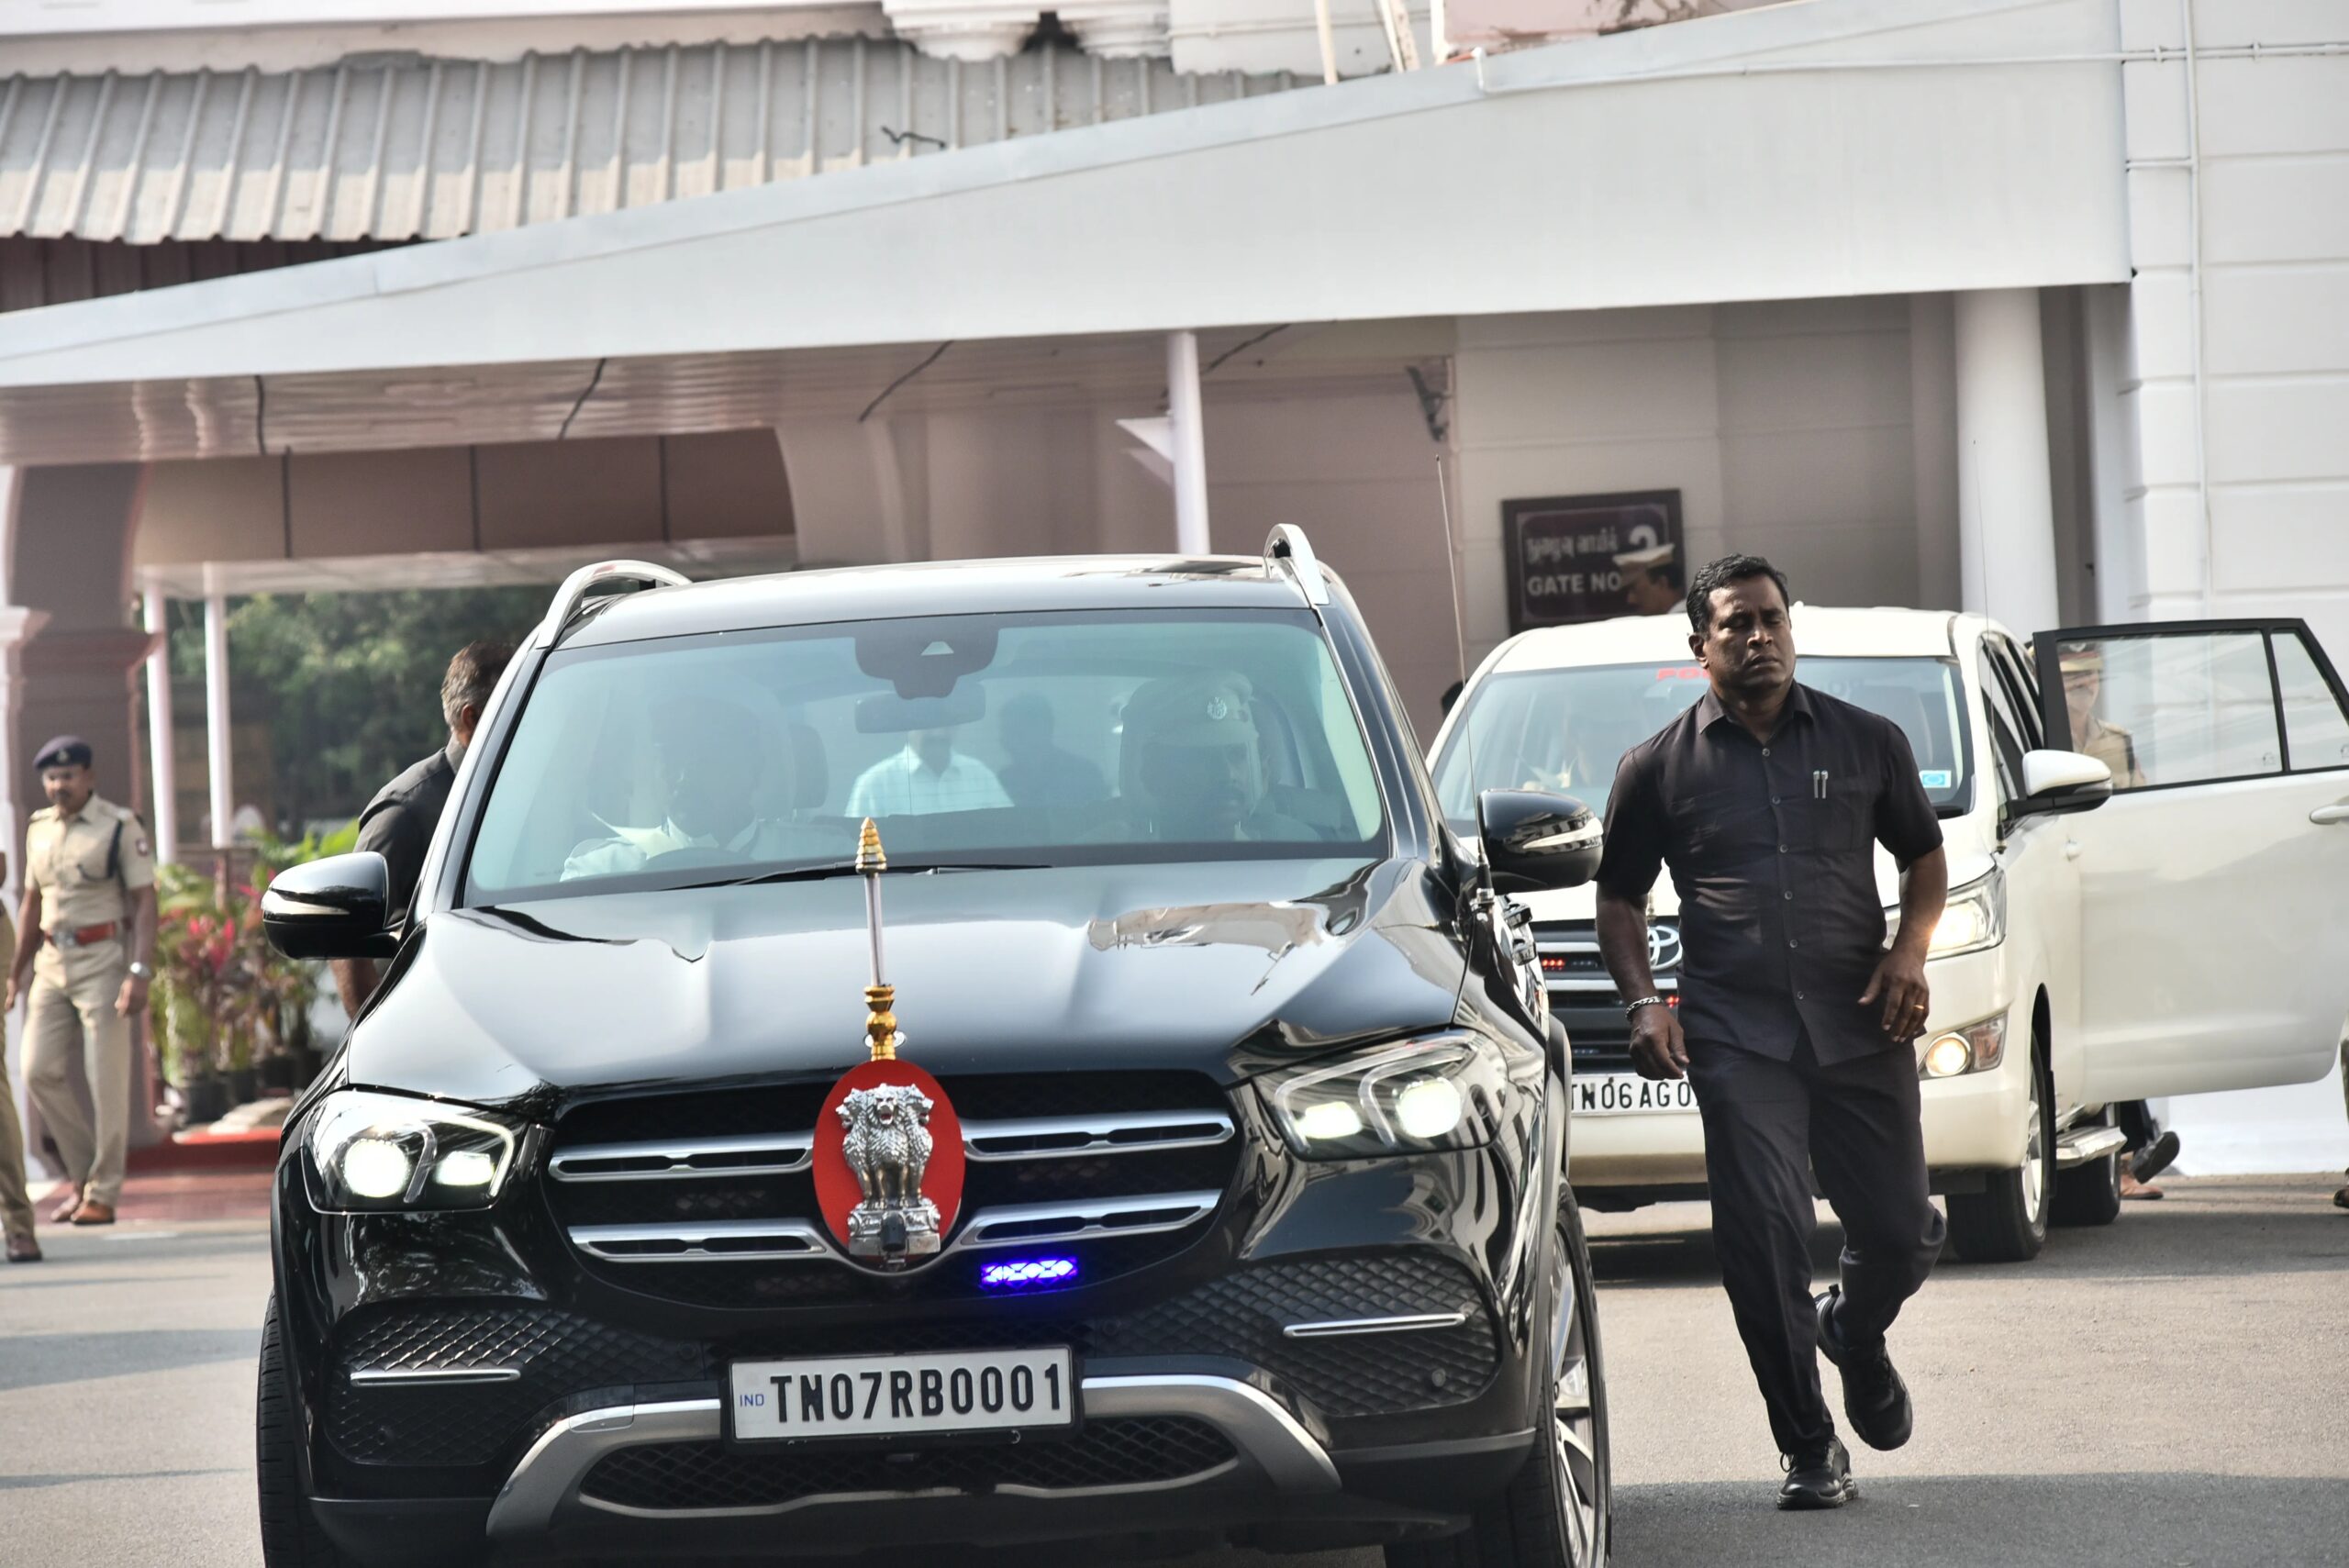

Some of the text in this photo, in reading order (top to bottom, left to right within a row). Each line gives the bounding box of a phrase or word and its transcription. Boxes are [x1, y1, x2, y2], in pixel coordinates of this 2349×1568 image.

[1527, 571, 1623, 596] GATE NO
[1656, 667, 1710, 682] PO
[1572, 1081, 1699, 1111] TN06AG0
[740, 1362, 1061, 1423] IND TN07RB0001
